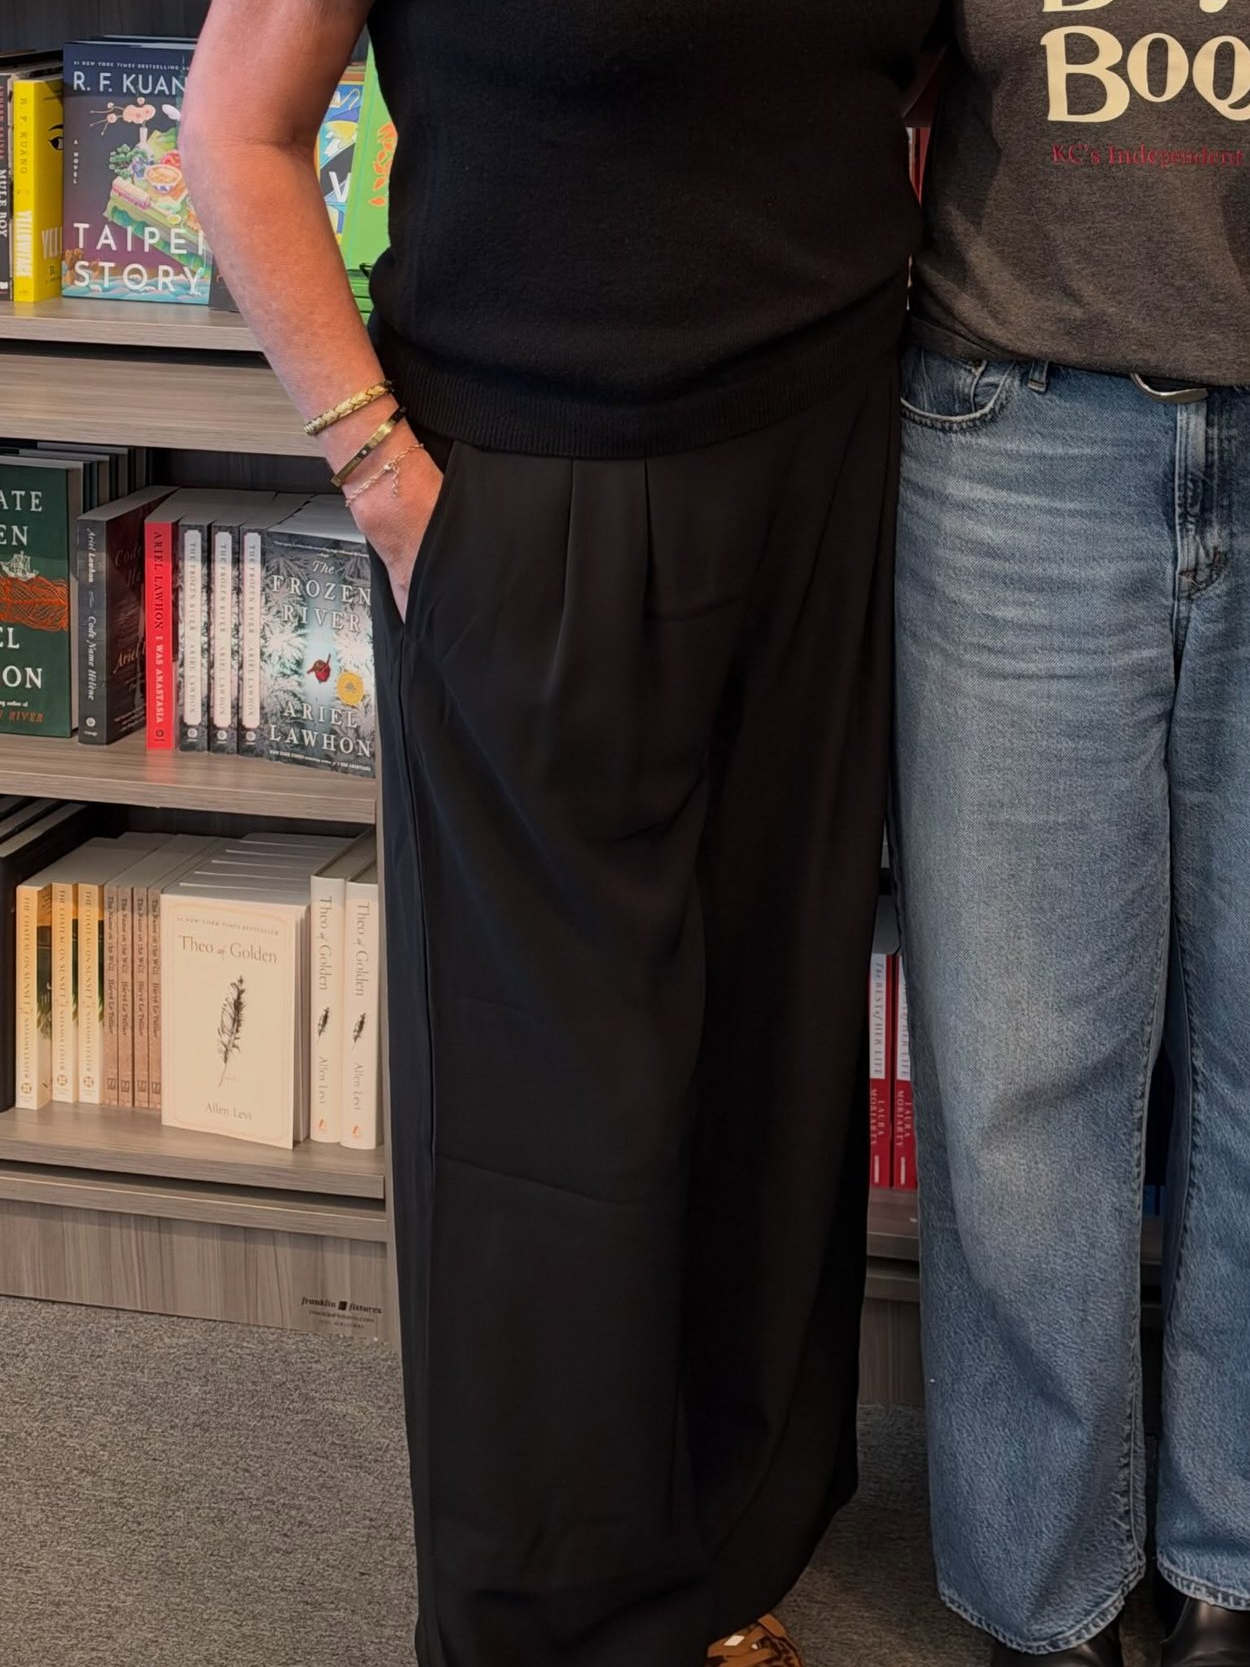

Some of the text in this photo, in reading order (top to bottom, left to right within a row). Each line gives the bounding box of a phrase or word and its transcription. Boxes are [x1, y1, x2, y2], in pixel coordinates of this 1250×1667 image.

[73, 71, 186, 97] R. F. KUAN
[1052, 144, 1100, 165] KC's
[1107, 143, 1244, 169] Independent
[75, 261, 200, 296] STORY
[312, 561, 336, 575] The
[272, 575, 371, 606] FROZEN
[283, 604, 361, 633] RIVER
[283, 705, 358, 729] ARIEL
[269, 728, 372, 758] LAWHON
[178, 935, 214, 955] Theo
[229, 941, 278, 964] Golden
[204, 1101, 253, 1121] Allen Levi
